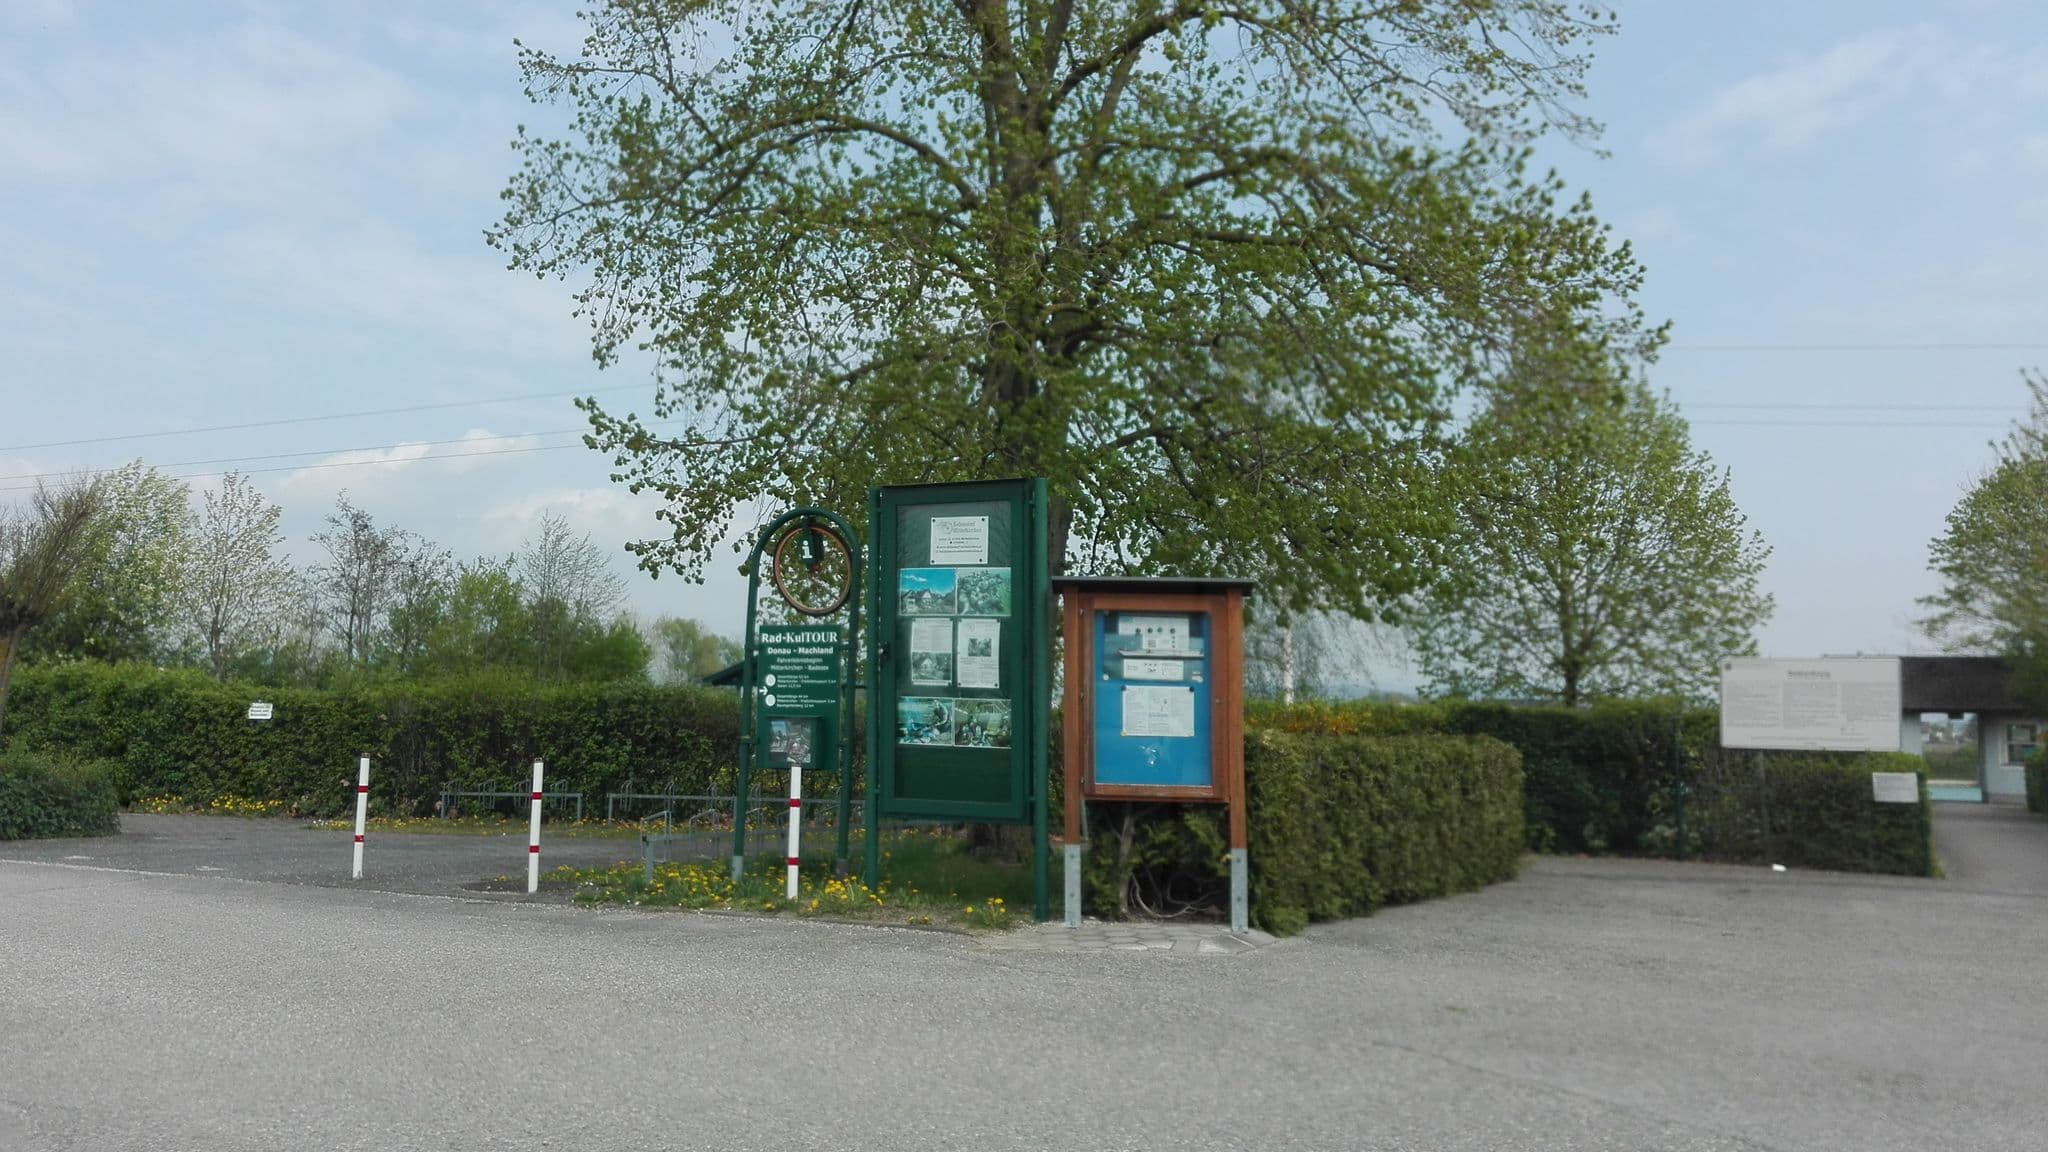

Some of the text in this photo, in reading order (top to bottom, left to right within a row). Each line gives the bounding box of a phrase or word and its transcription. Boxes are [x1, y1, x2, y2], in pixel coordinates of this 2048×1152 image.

[802, 540, 813, 559] i
[761, 631, 838, 643] Rad-KulTOUR
[767, 646, 792, 655] Donau
[798, 646, 834, 655] Machland
